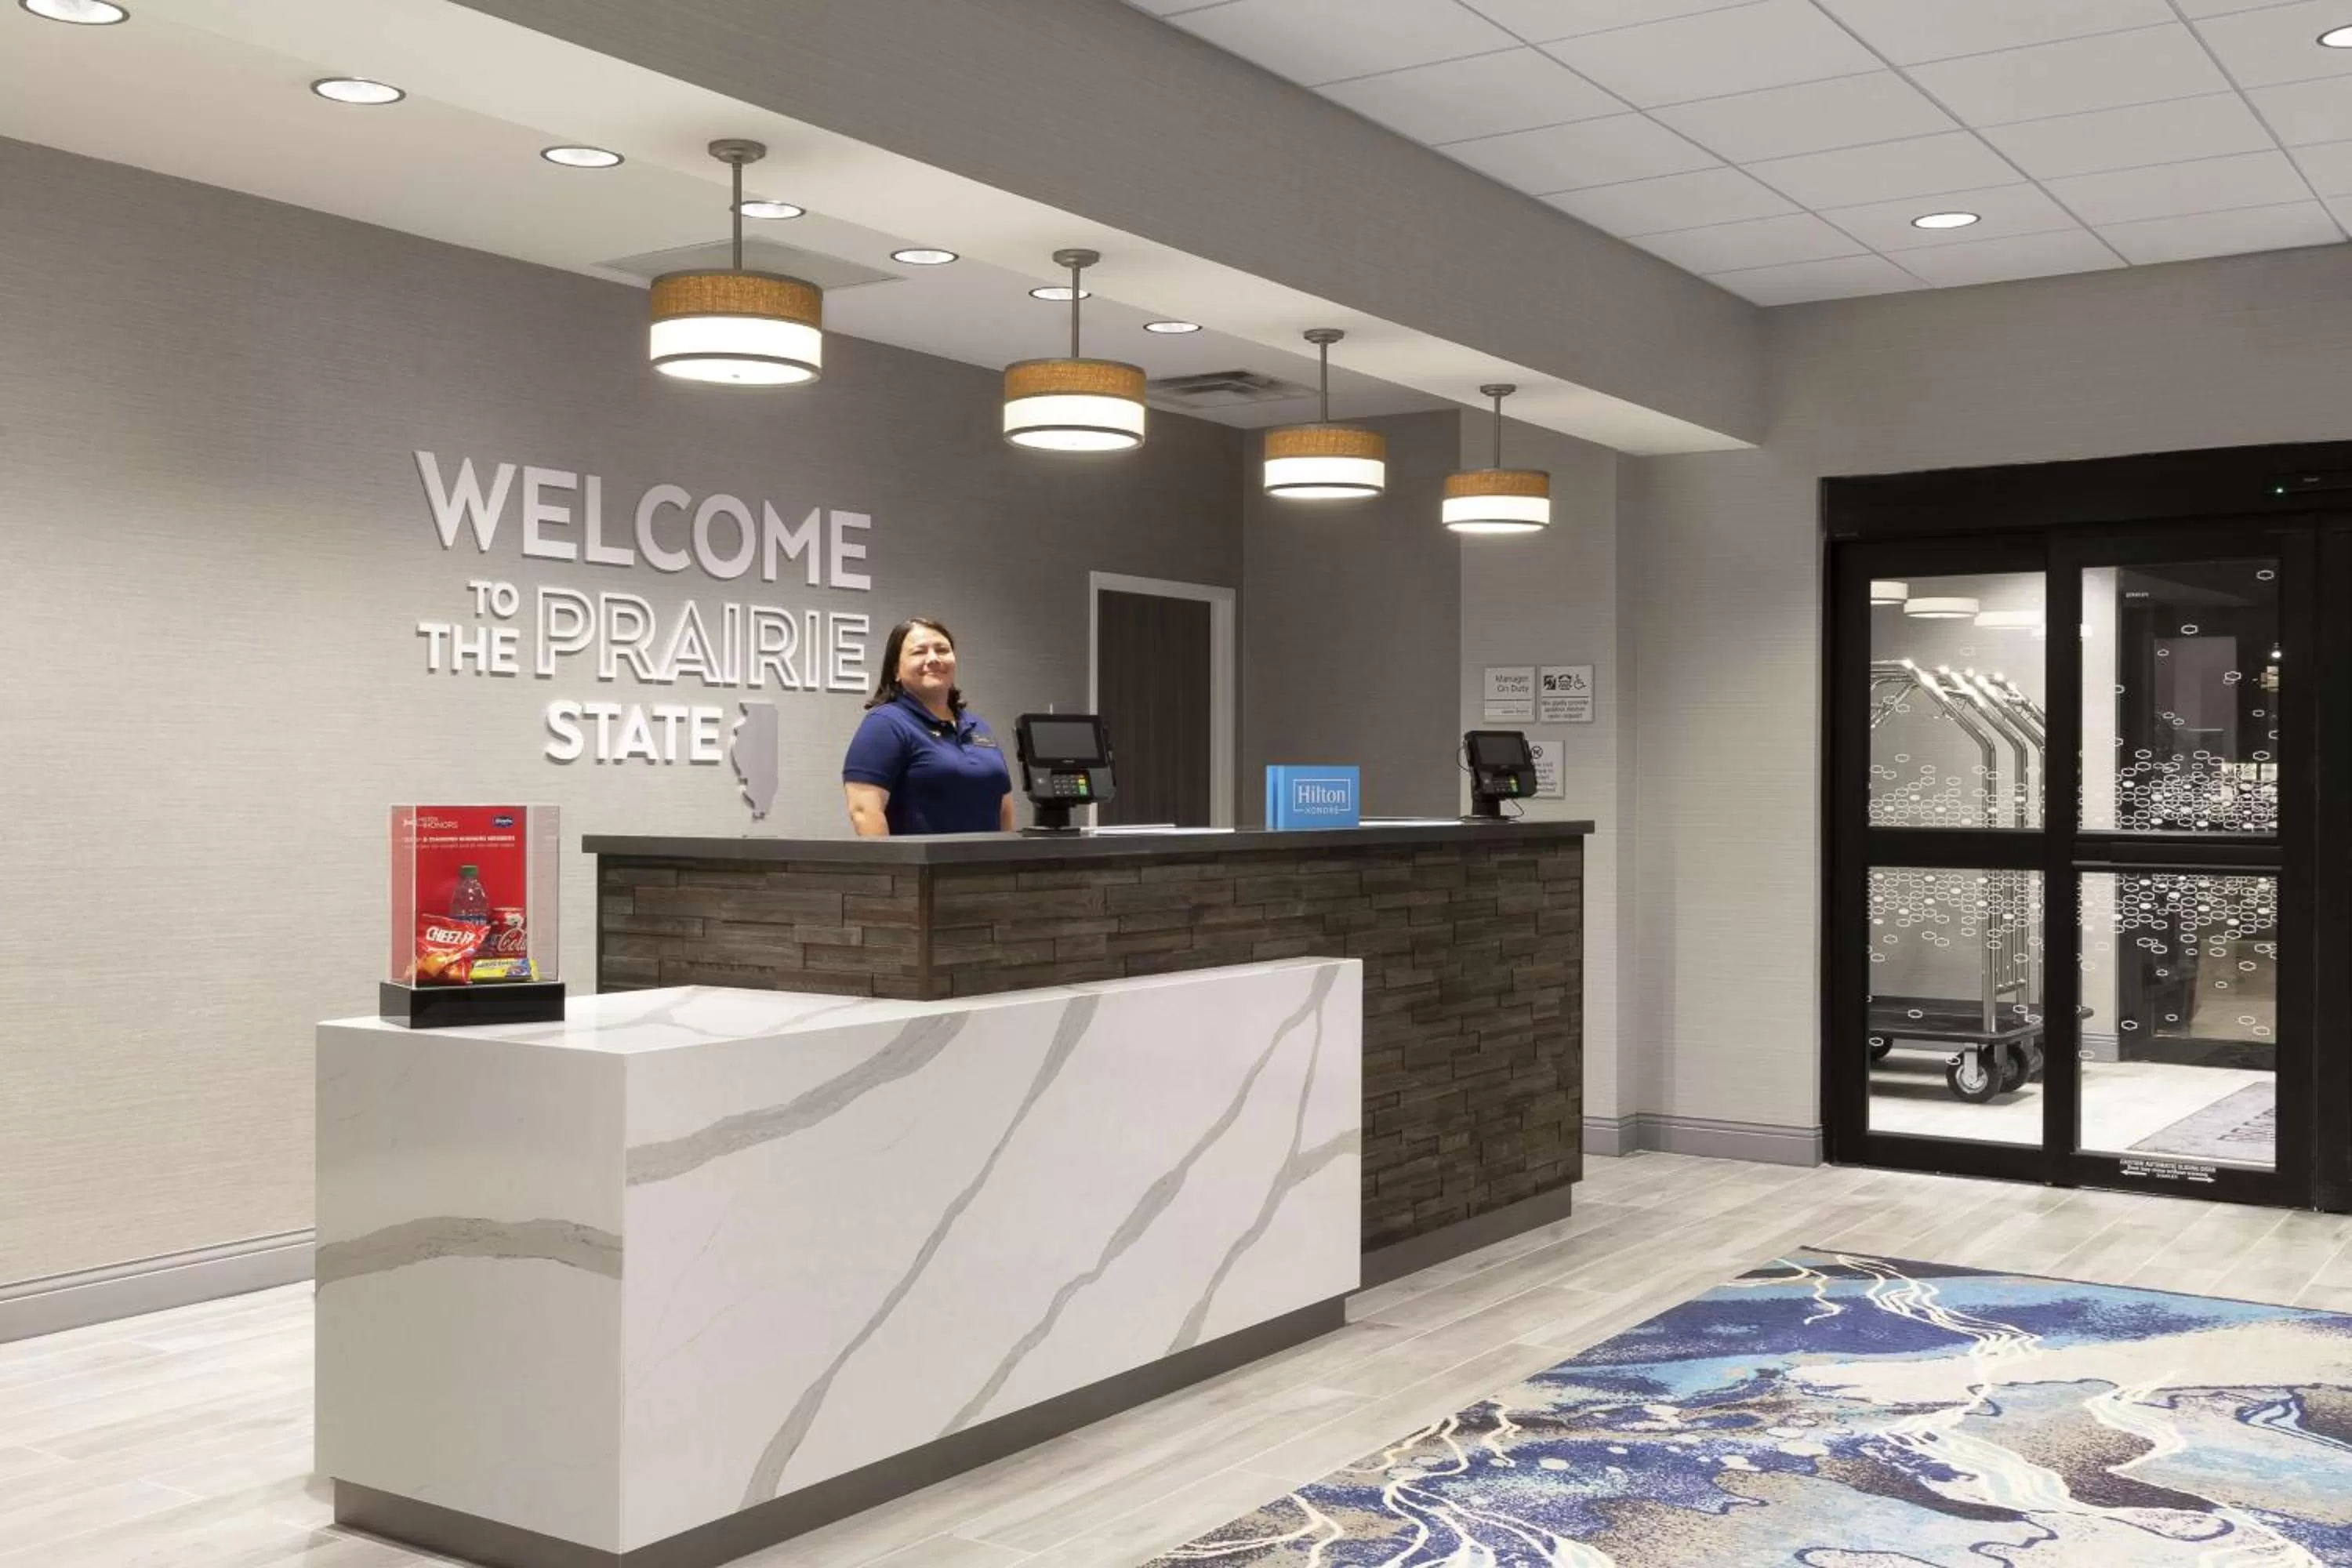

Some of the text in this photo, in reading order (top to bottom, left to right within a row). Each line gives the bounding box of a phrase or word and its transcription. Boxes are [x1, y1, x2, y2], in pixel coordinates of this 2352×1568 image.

[413, 450, 872, 590] WELCOME
[468, 580, 520, 618] TO
[417, 586, 870, 691] THE PRAIRIE
[1512, 684, 1530, 694] Duty
[545, 700, 723, 764] STATE
[1298, 785, 1346, 804] Hilton
